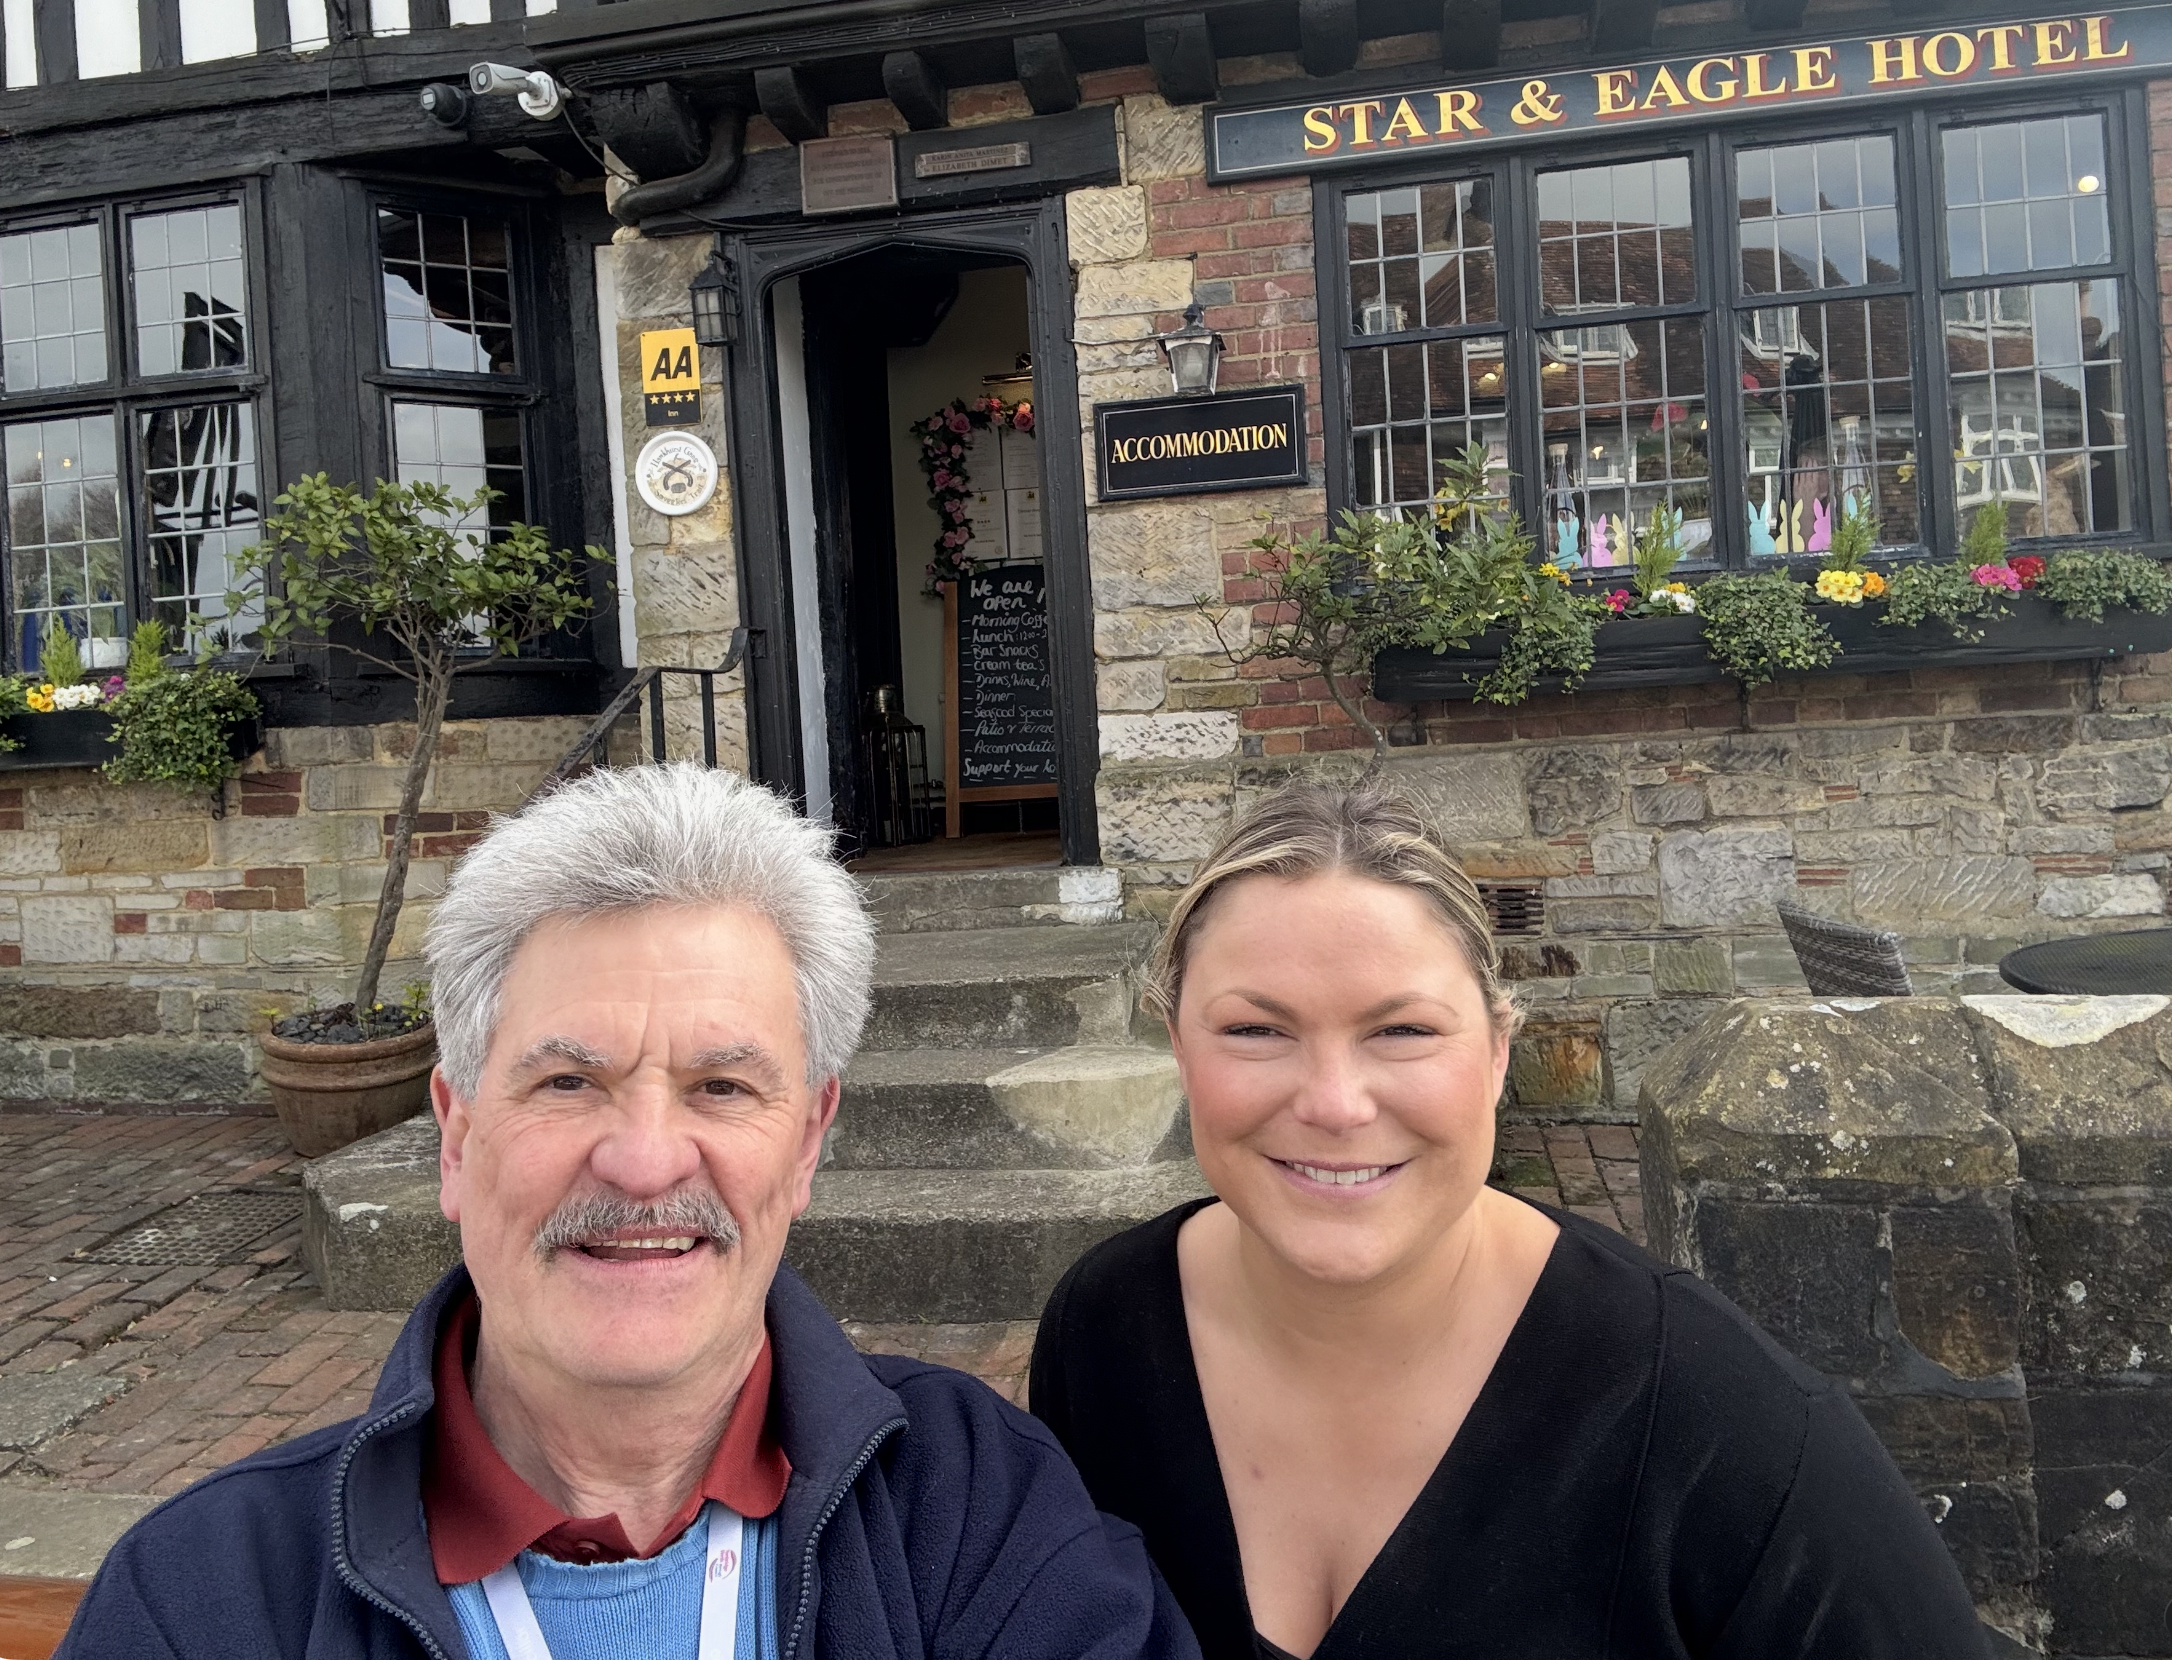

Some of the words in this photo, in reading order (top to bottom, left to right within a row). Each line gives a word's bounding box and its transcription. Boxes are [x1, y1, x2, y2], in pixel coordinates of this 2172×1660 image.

[1303, 90, 1489, 153] STAR
[1510, 80, 1566, 127] &
[1591, 46, 1839, 118] EAGLE
[1866, 16, 2131, 86] HOTEL
[932, 161, 977, 172] ELIZABETH
[981, 158, 1007, 167] DIMET
[650, 346, 693, 381] AA
[667, 409, 679, 417] Inn
[1111, 423, 1287, 463] ACCOMMODATION
[970, 579, 993, 598] We
[1002, 580, 1034, 595] are
[971, 611, 1020, 633] Morning
[972, 628, 1014, 643] Lunch
[970, 644, 997, 660] Bar
[974, 719, 1005, 736] Patio
[1018, 721, 1055, 733] Terrac
[963, 758, 1012, 777] Support
